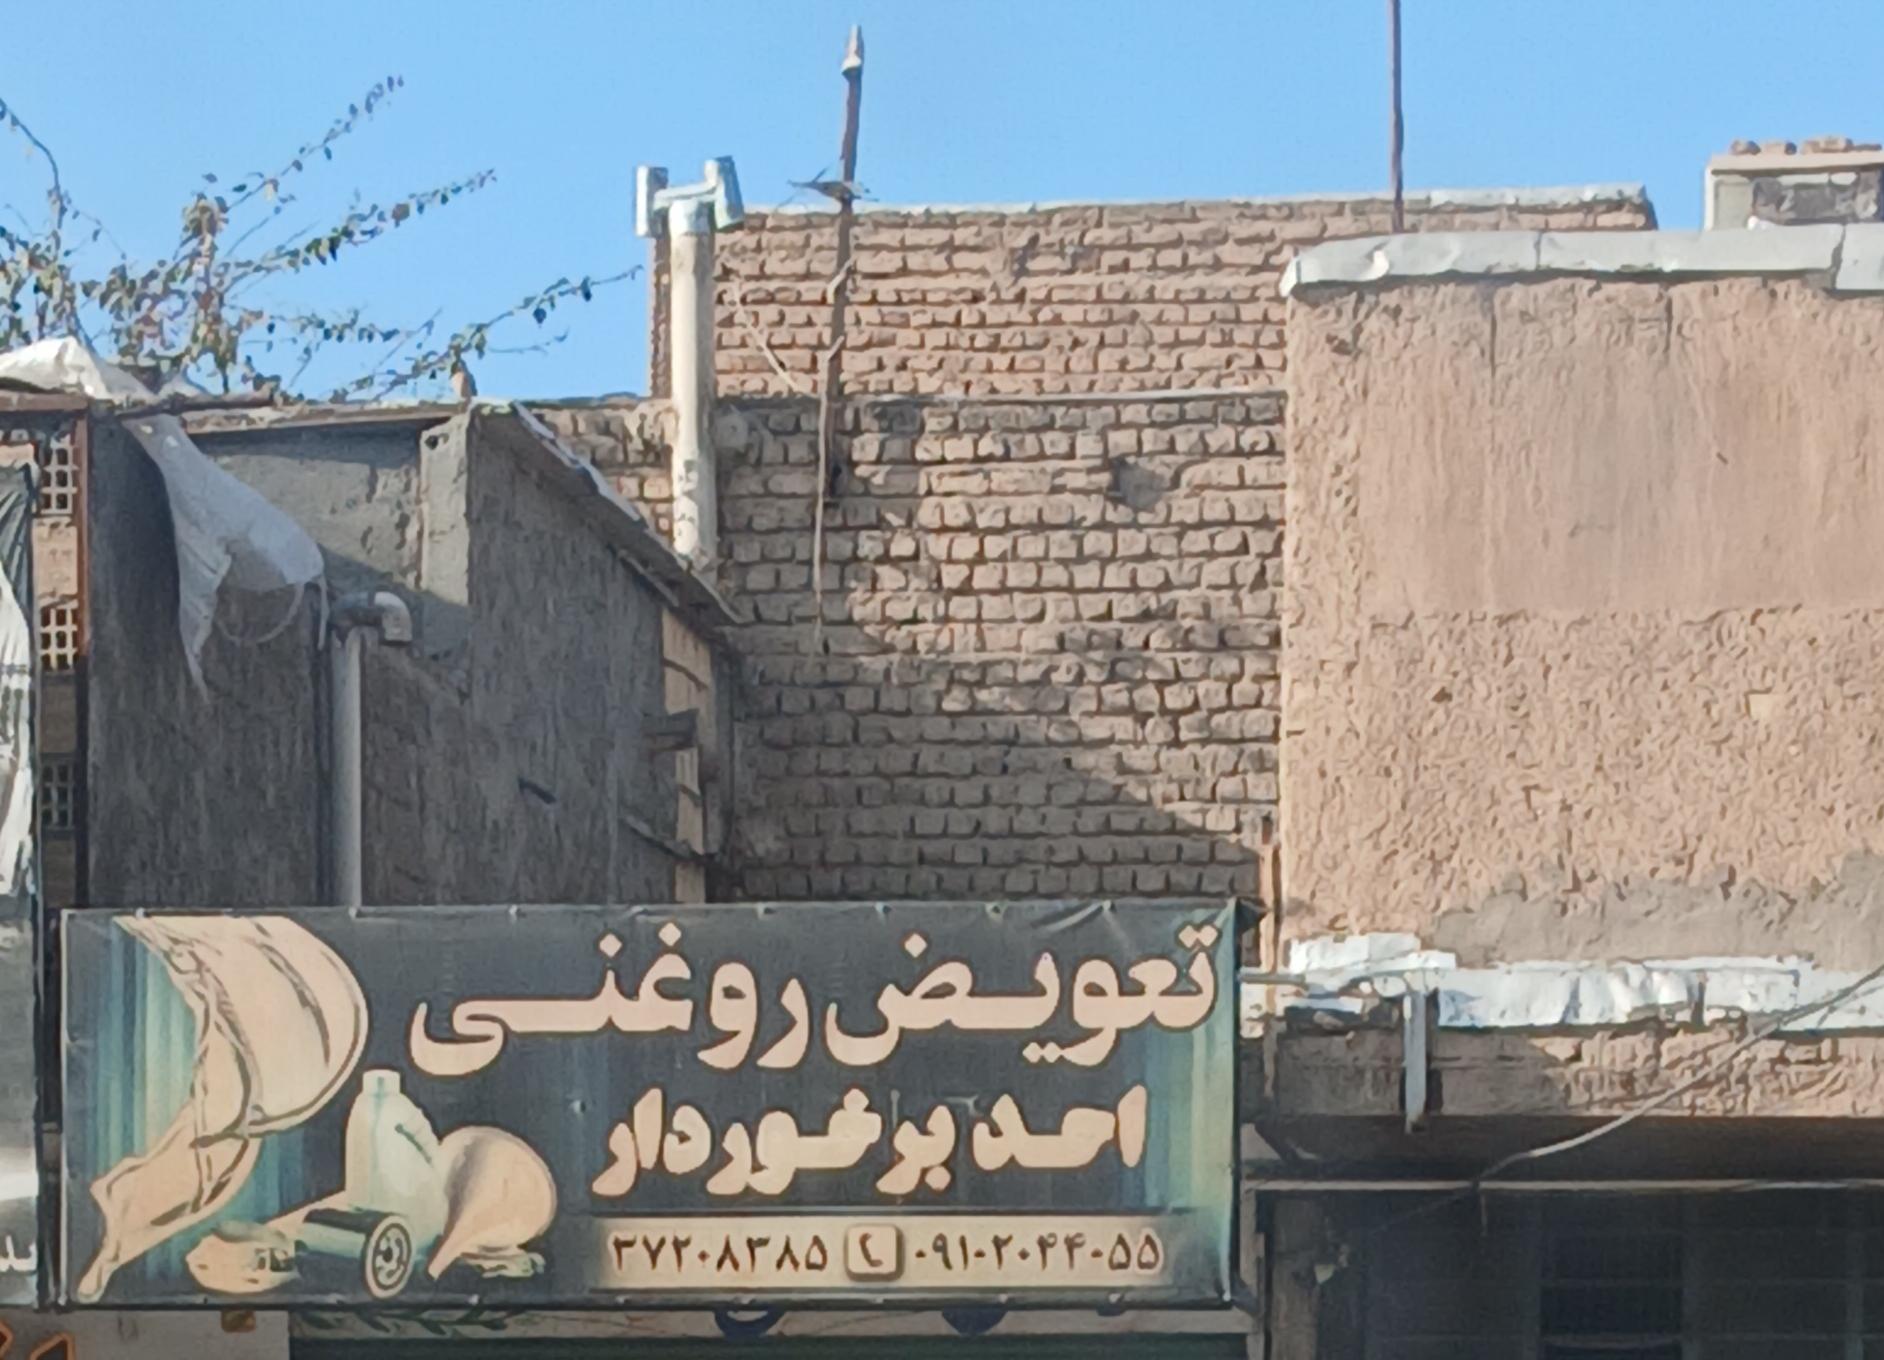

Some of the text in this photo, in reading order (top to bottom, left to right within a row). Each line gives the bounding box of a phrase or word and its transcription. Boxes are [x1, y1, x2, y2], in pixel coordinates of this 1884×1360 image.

[409, 921, 1219, 1077] تعویض روغنی
[591, 1083, 1148, 1197] احد برخوردار
